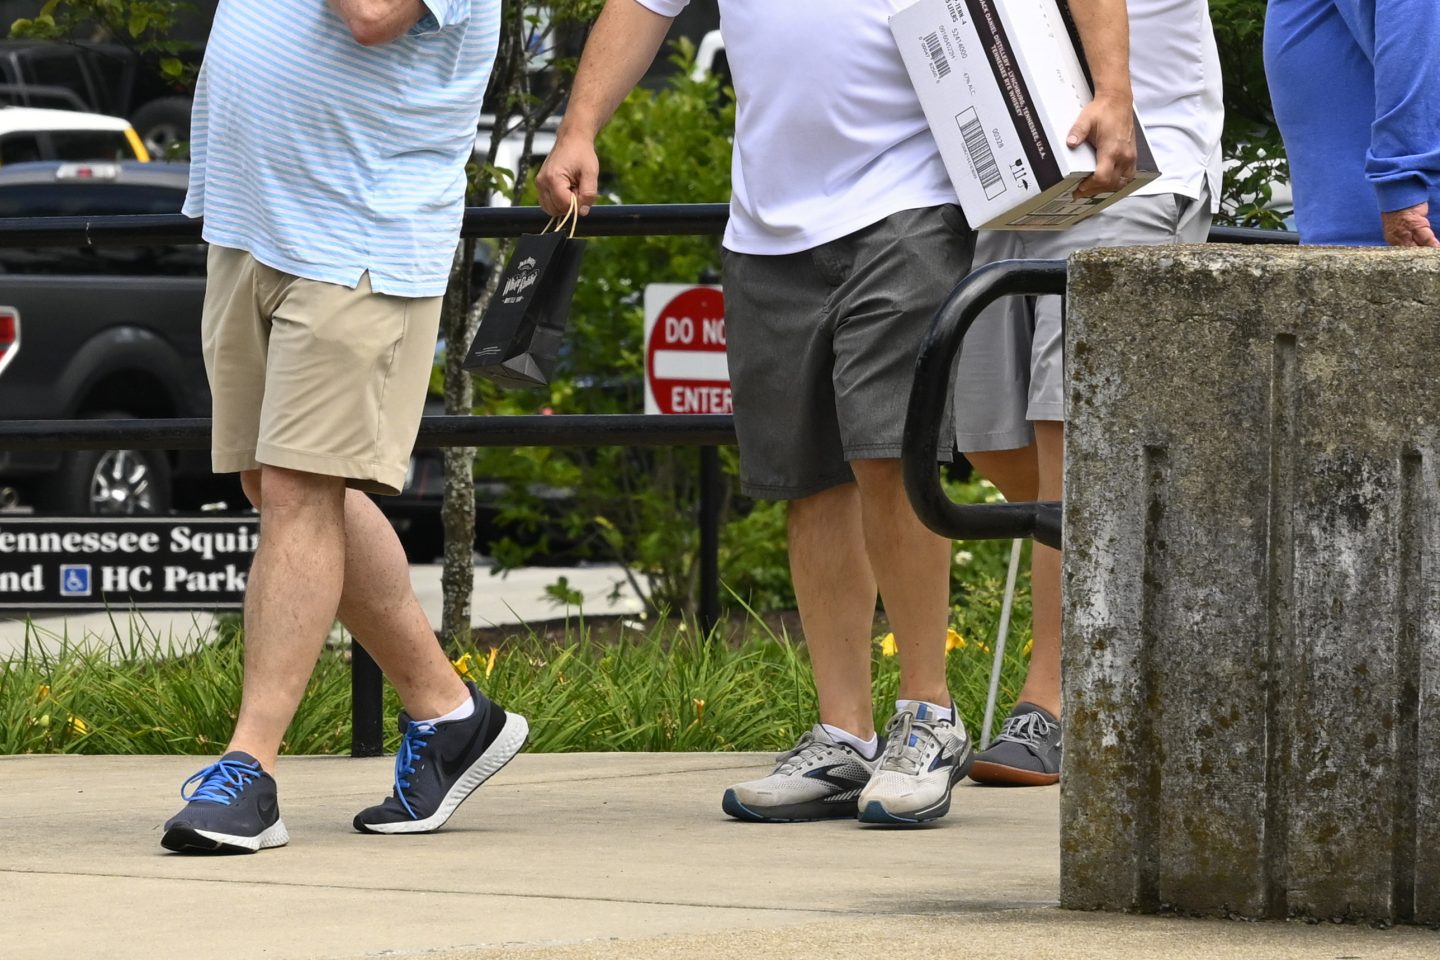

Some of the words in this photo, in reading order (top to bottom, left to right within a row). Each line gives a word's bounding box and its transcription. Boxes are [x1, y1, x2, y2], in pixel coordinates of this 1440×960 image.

[946, 3, 958, 22] LITERS
[967, 83, 975, 96] ALC
[984, 12, 996, 34] DANIEL
[993, 34, 1009, 66] DISTILLERY
[1035, 140, 1046, 159] U.S.A.
[990, 44, 1007, 78] TENNESSEE
[1003, 78, 1011, 90] RYE
[1008, 90, 1023, 117] WHISKEY
[664, 316, 694, 345] DO
[671, 386, 733, 413] ENTER
[101, 566, 152, 592] HC
[163, 564, 247, 592] Park
